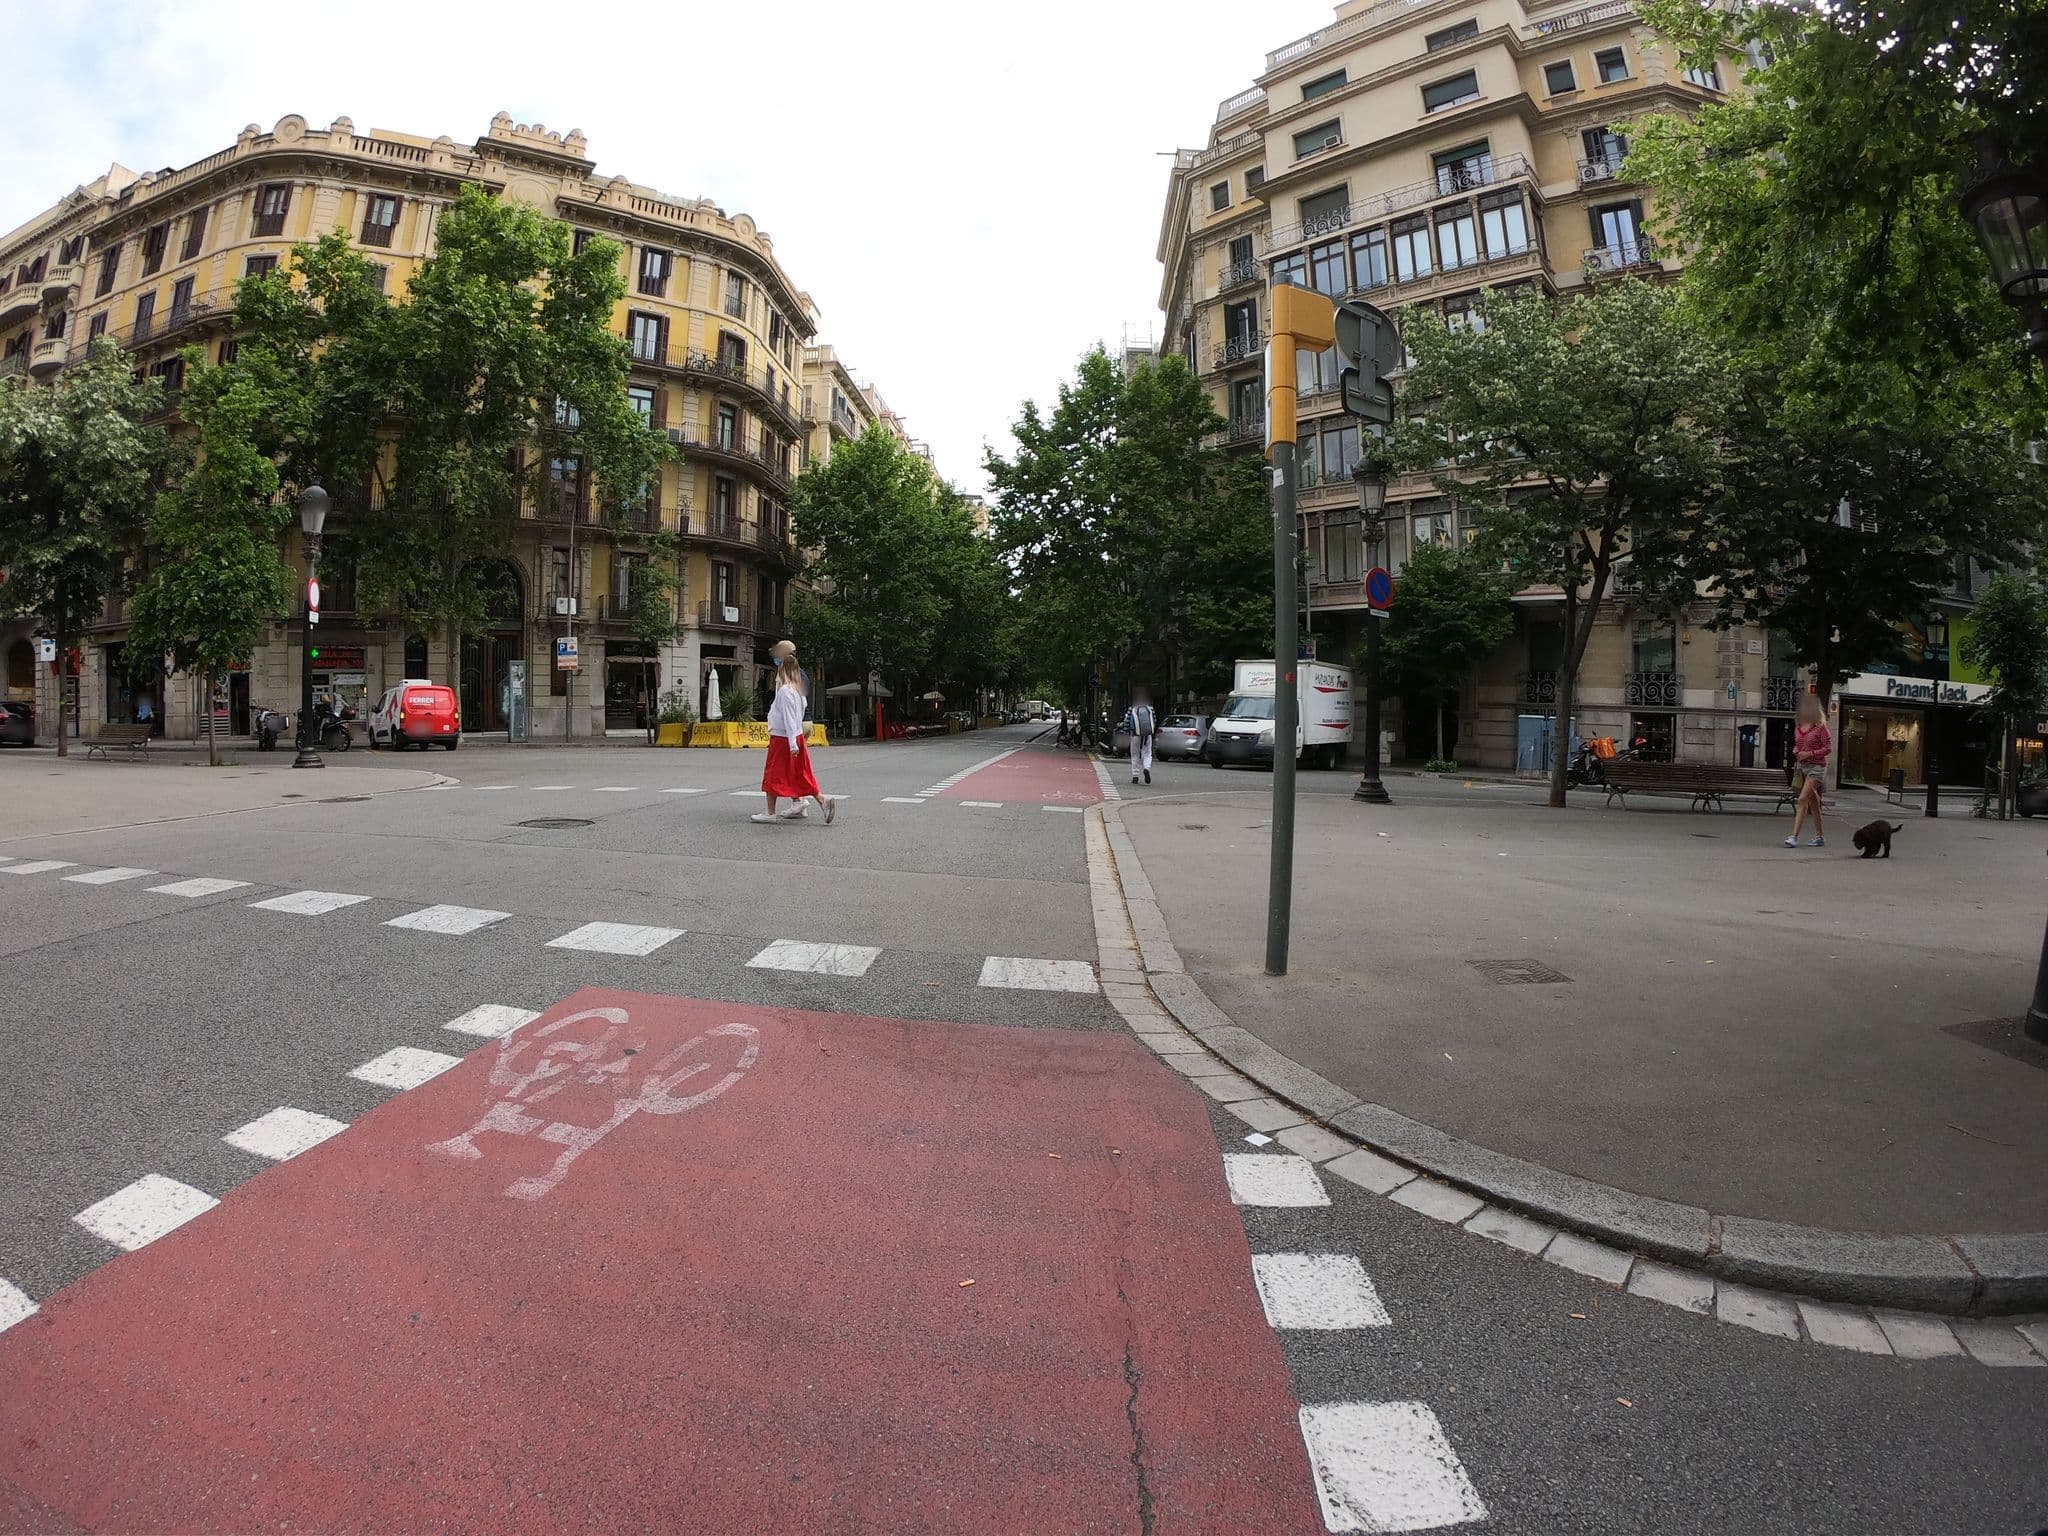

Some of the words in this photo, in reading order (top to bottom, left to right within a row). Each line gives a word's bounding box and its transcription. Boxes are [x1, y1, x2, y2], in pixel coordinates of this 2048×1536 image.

[1887, 678, 1937, 698] Panama
[1940, 683, 1968, 702] Jack
[409, 696, 435, 704] FERRER
